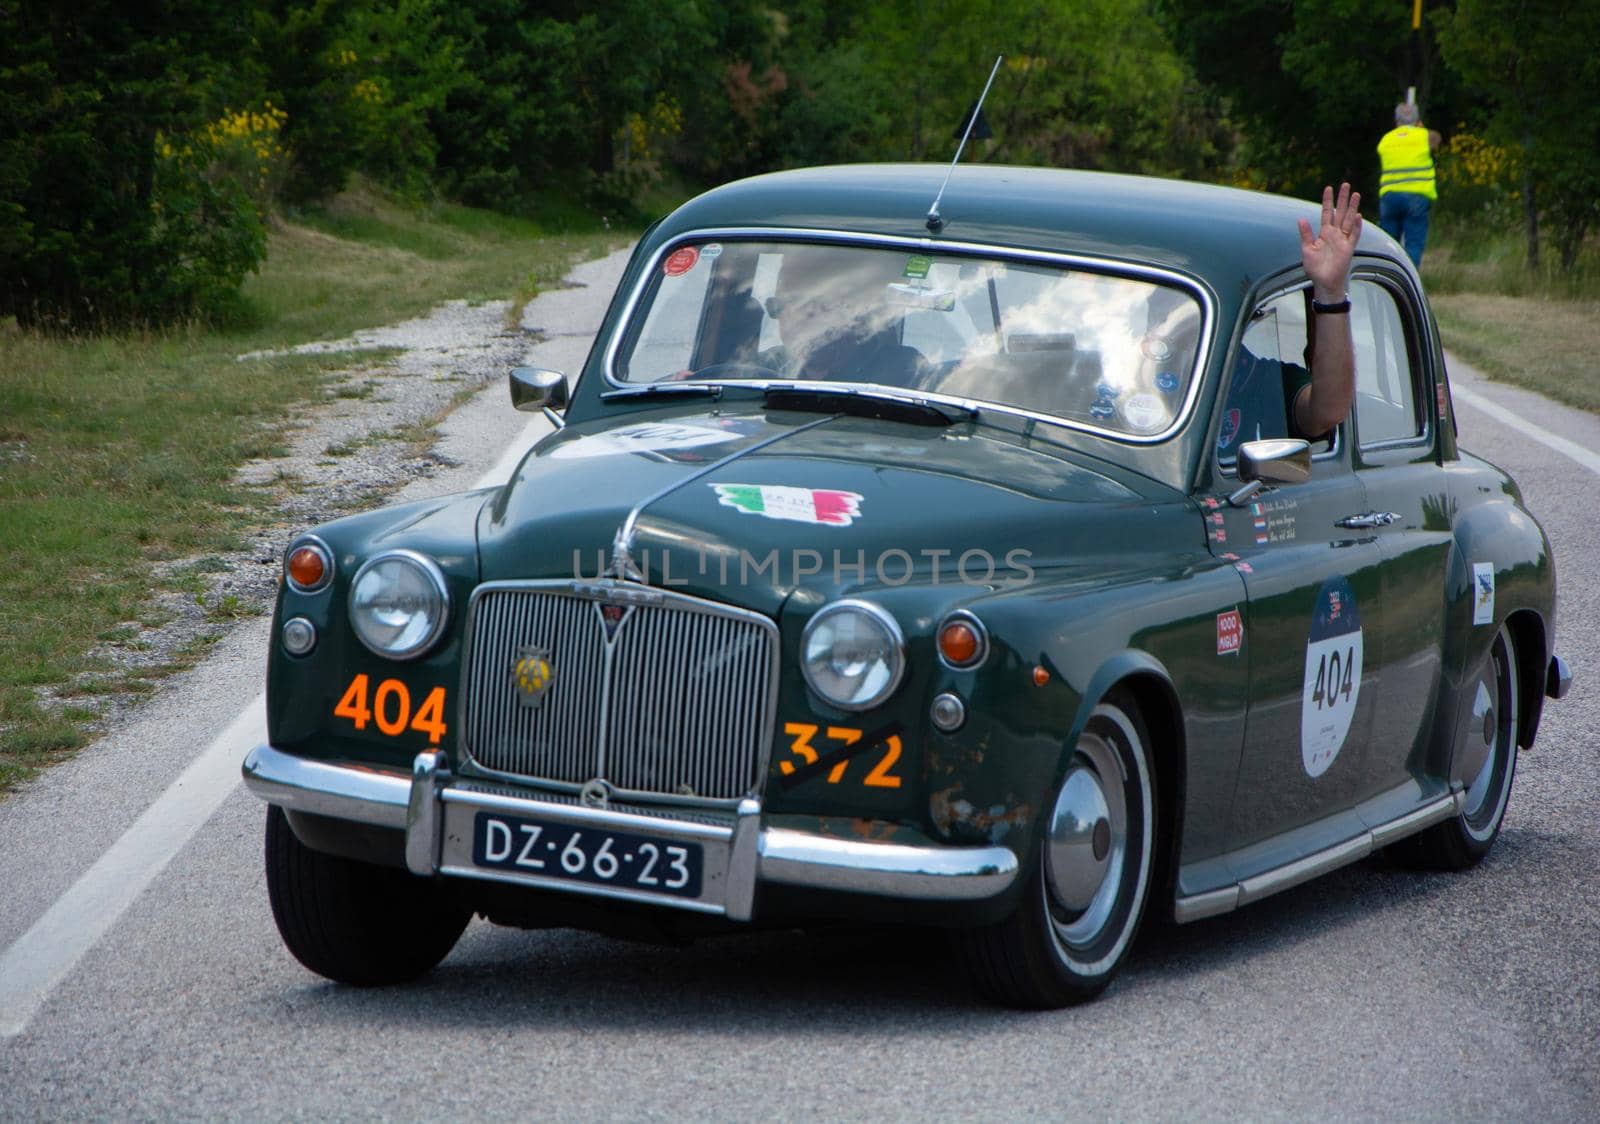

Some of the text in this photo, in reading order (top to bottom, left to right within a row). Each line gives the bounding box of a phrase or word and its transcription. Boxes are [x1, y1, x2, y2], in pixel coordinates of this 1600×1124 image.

[1220, 615, 1237, 631] 1000
[334, 674, 447, 744] 404
[1312, 646, 1353, 711] 404
[779, 722, 903, 788] 372
